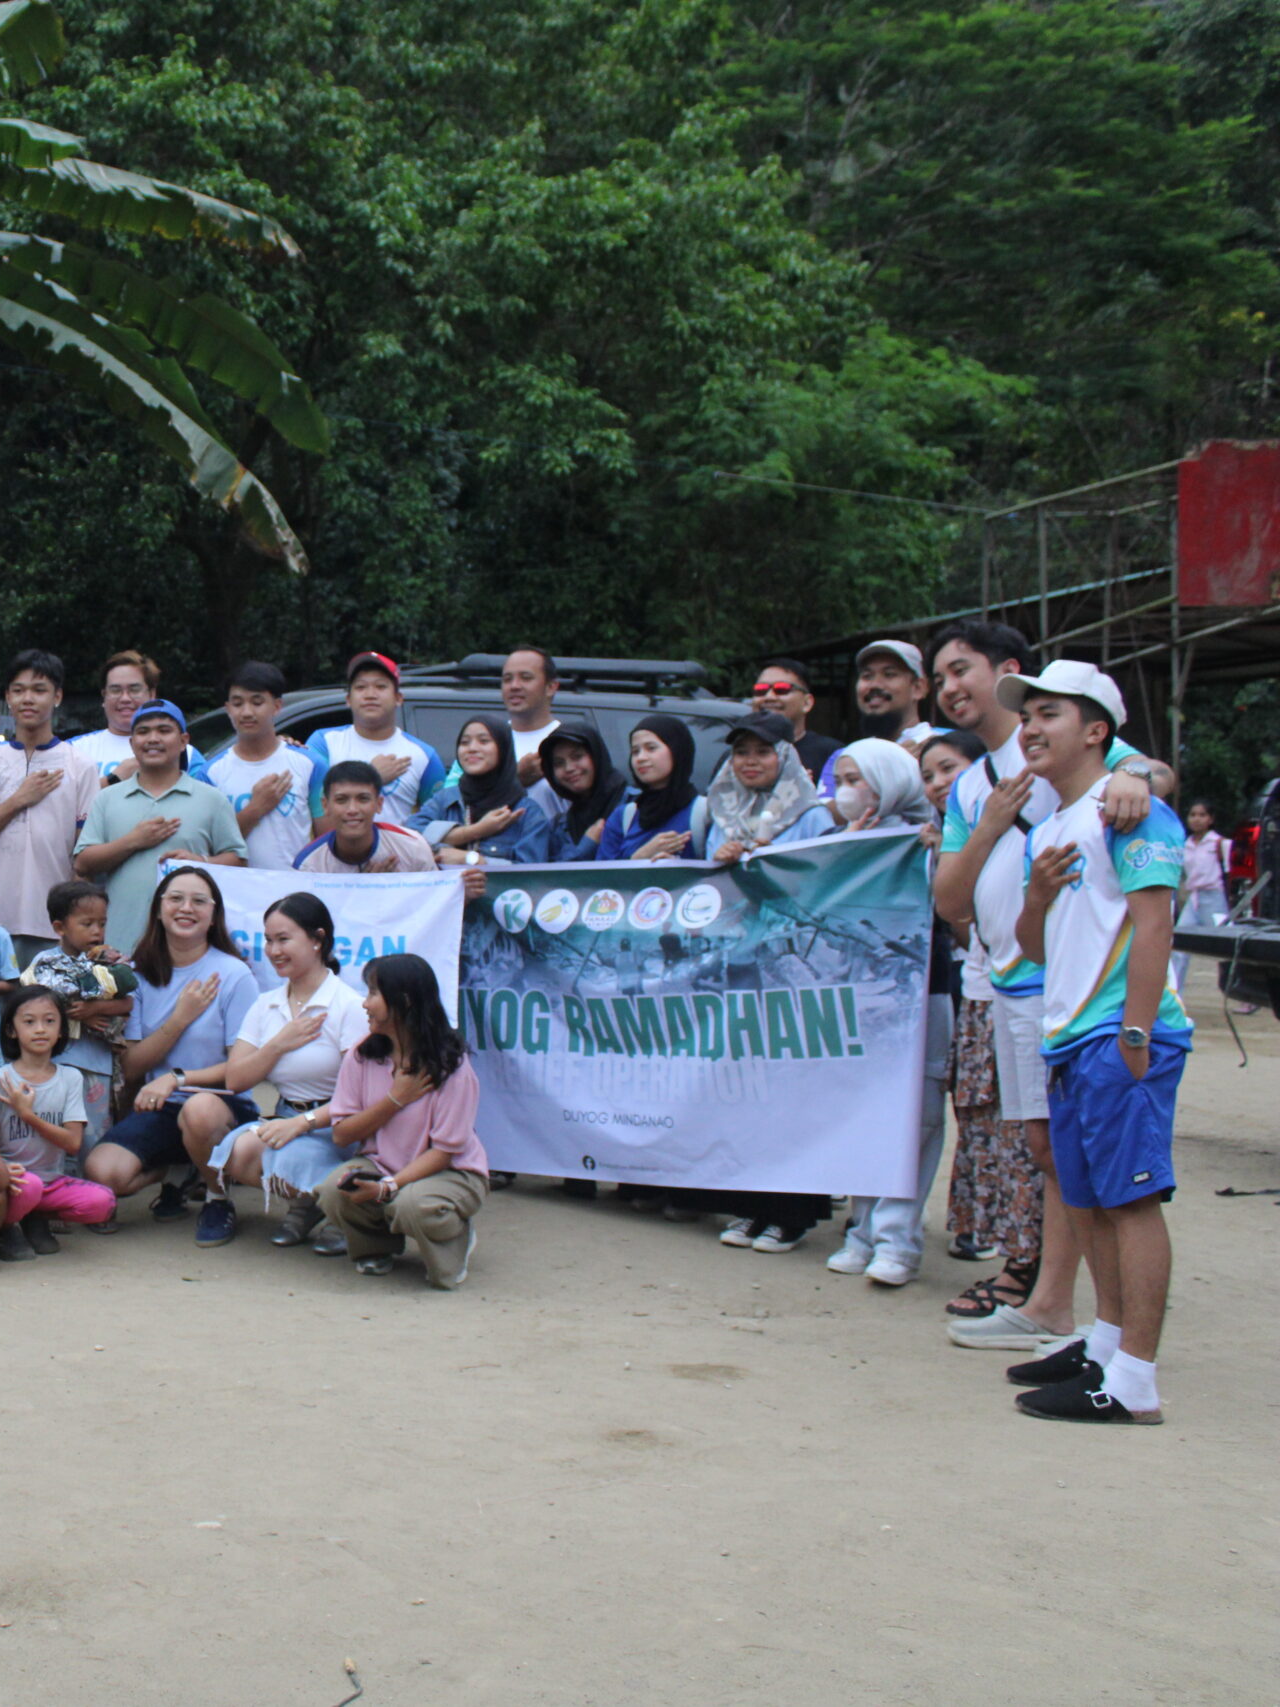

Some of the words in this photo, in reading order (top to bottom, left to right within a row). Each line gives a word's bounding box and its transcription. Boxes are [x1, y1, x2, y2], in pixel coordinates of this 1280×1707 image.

[333, 935, 406, 968] GAN
[562, 986, 864, 1061] RAMADHAN!
[563, 1109, 609, 1124] DUYOG
[612, 1113, 675, 1128] MINDANAO
